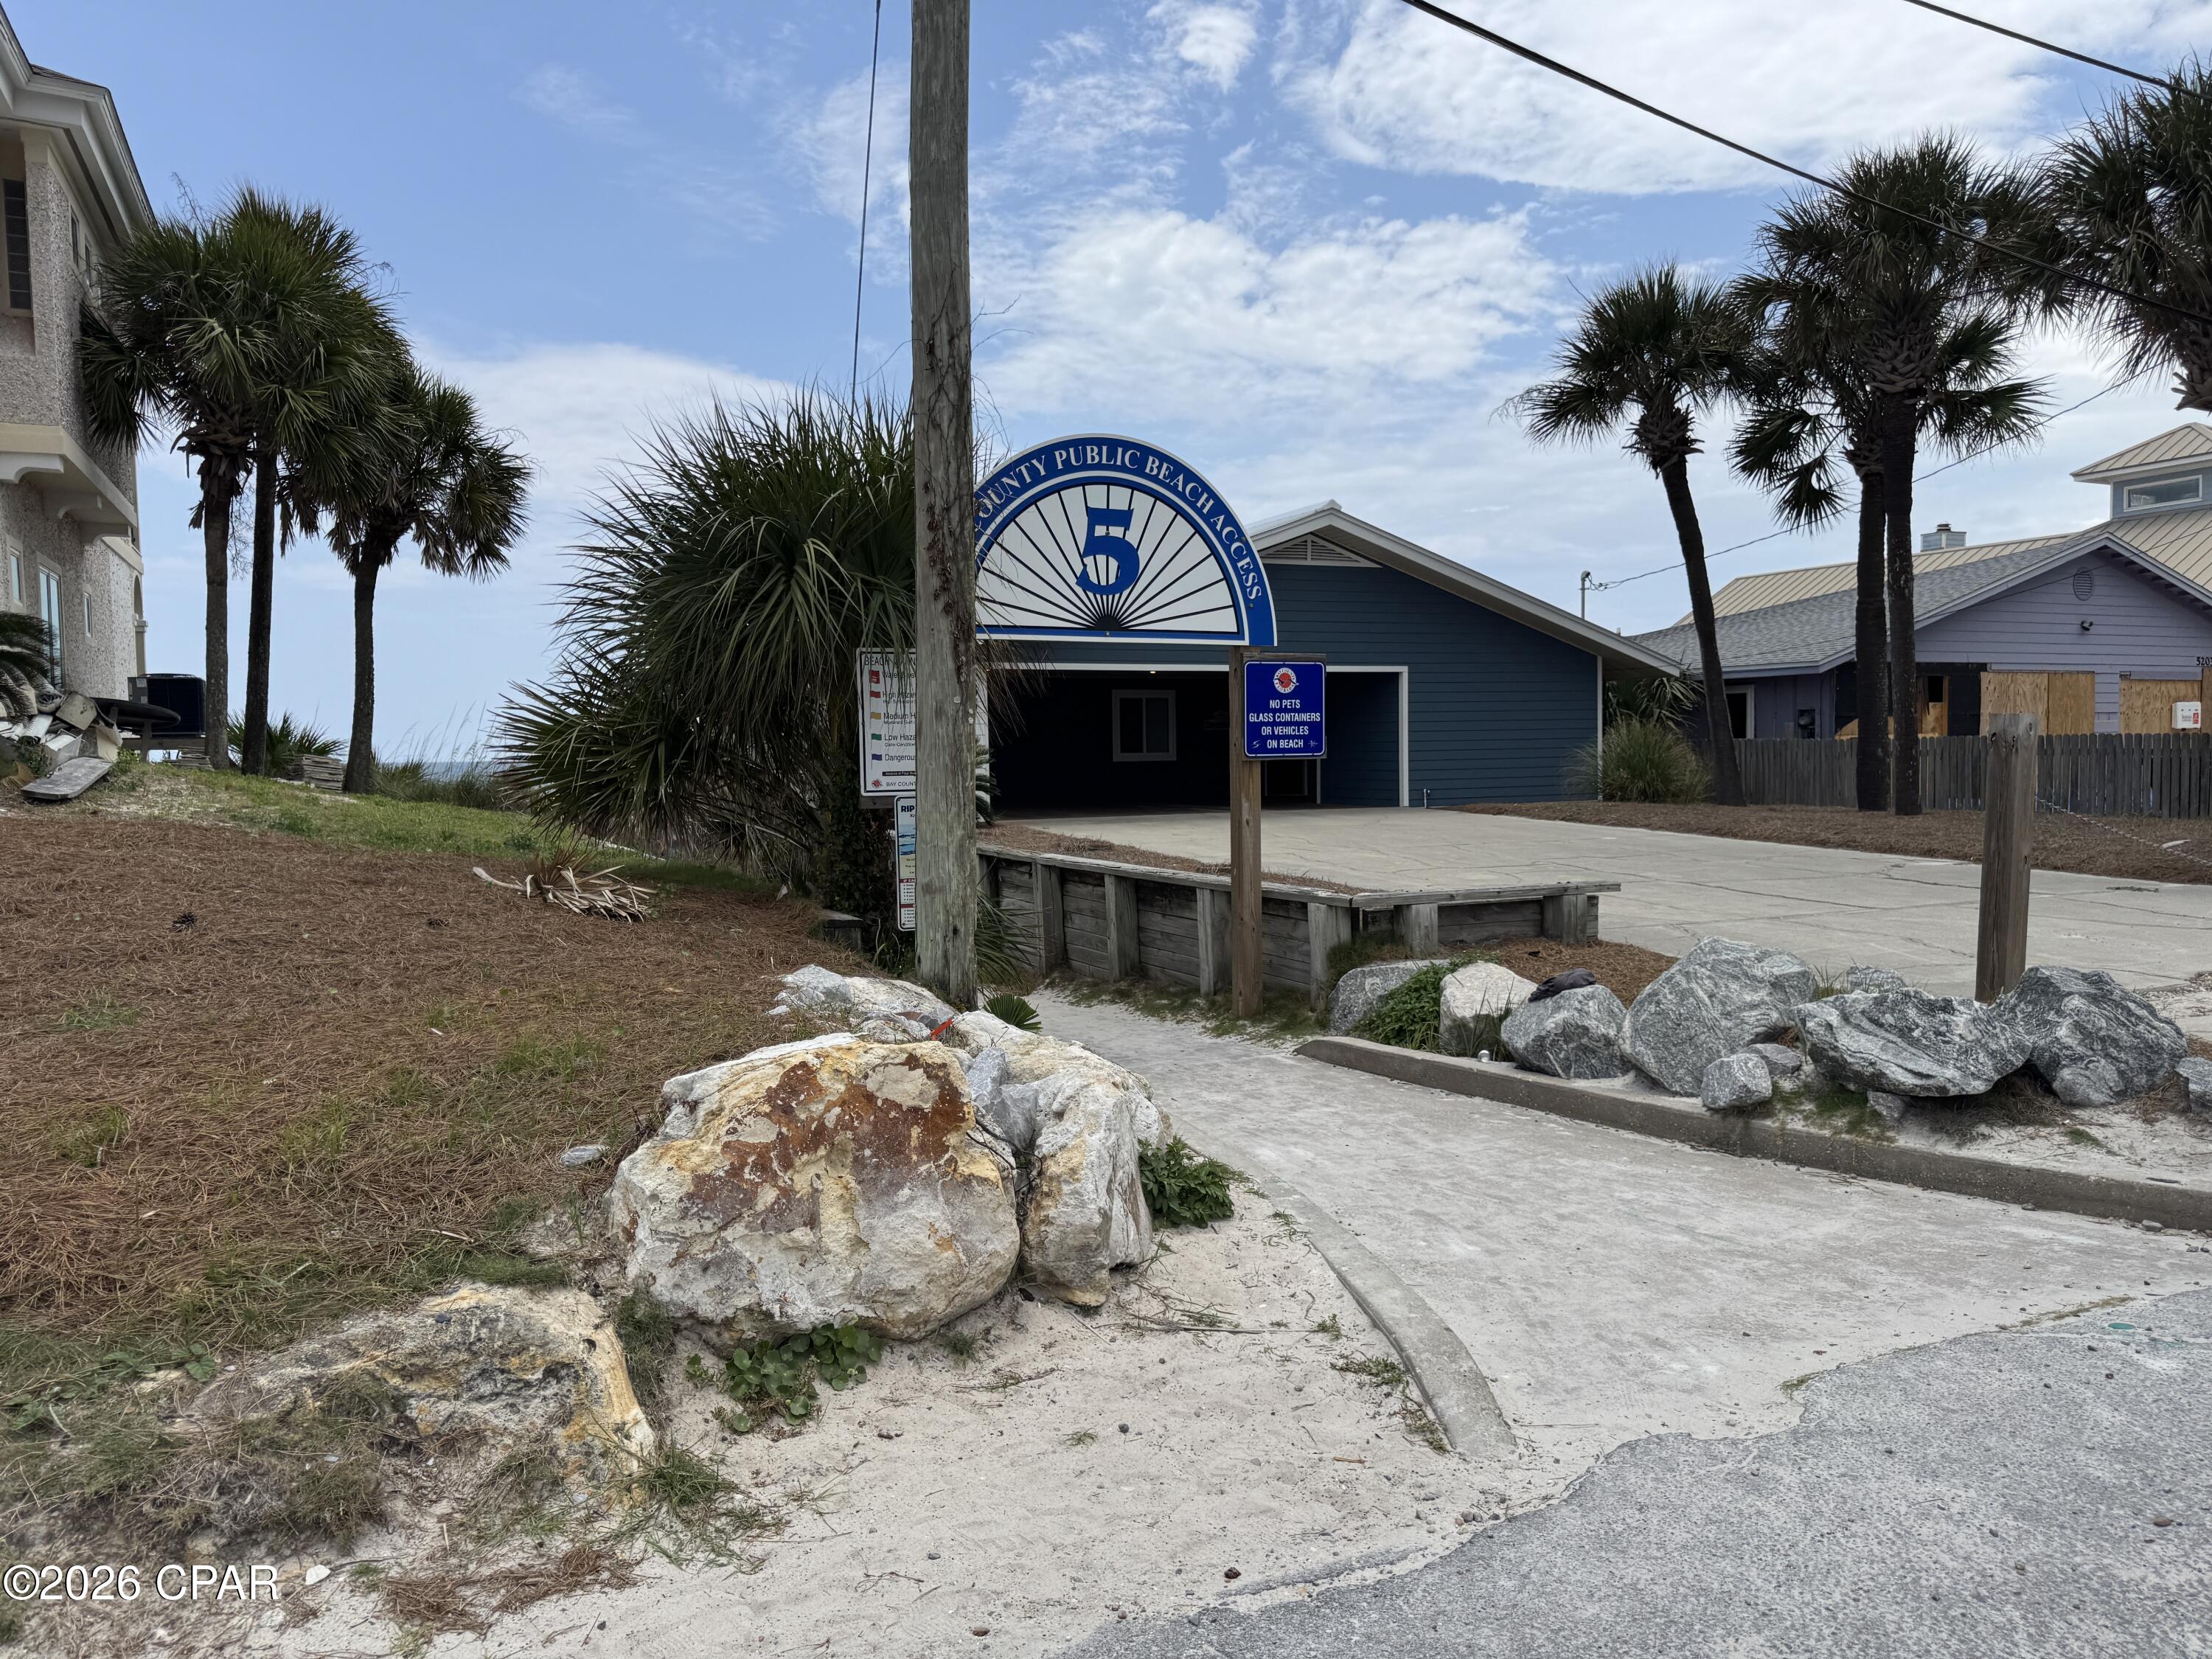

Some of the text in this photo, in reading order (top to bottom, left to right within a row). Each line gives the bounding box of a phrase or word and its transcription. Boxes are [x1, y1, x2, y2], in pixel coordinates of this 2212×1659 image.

[1054, 445, 1140, 470] PUBLIC
[1144, 456, 1216, 515] BEACH
[1210, 515, 1262, 600] ACCESS
[1076, 507, 1141, 596] 5
[1270, 700, 1301, 709] NO PETS
[1249, 713, 1321, 722] GLASS CONTAINERS
[1262, 726, 1309, 735] OR VEHICLES
[1267, 740, 1304, 748] ON BEACH
